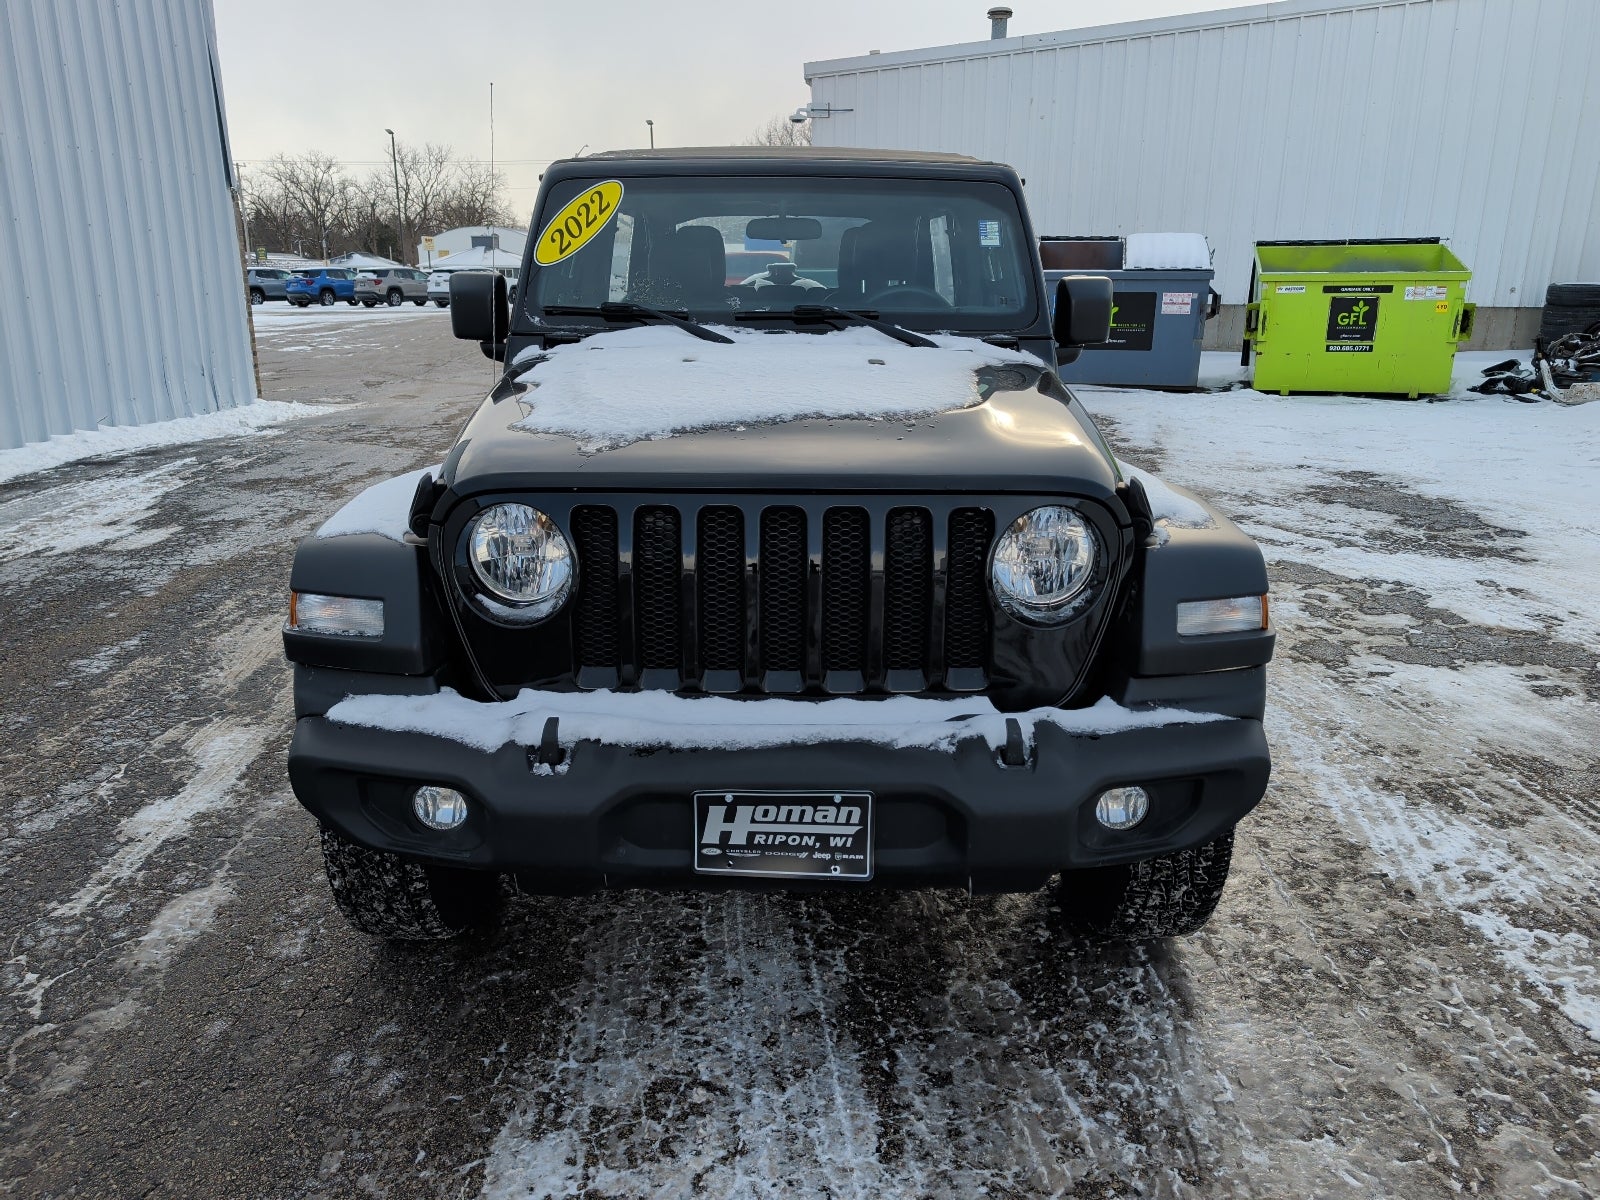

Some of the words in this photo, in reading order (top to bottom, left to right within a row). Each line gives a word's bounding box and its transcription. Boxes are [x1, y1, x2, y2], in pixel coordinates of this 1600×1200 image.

[551, 191, 610, 255] 2022
[1337, 312, 1367, 326] GFL
[701, 805, 862, 845] Homan
[753, 834, 821, 848] RIPON,
[829, 836, 853, 848] WI
[812, 852, 831, 860] Jeep
